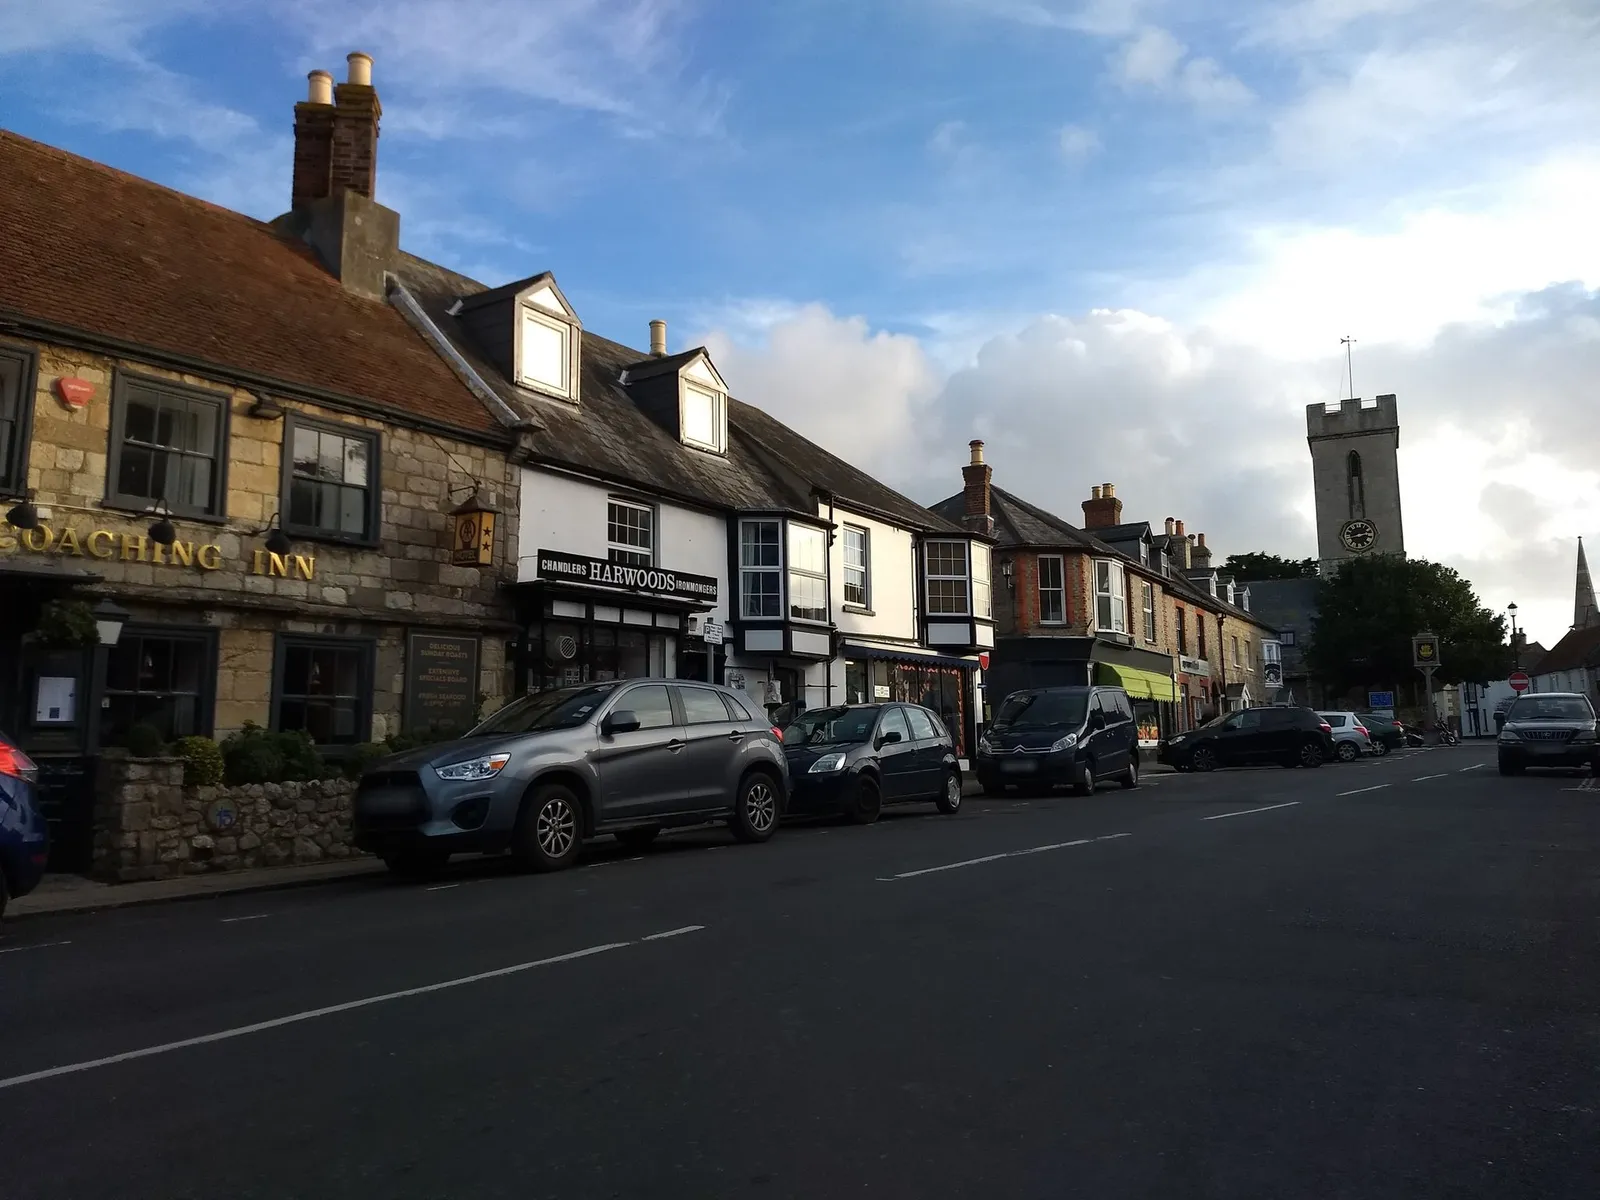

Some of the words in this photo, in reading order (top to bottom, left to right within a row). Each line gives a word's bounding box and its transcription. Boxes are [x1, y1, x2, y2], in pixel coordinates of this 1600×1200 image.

[253, 549, 315, 580] INN
[541, 559, 587, 575] CHANDLERS
[589, 562, 675, 591] HARWOODS
[676, 579, 717, 595] IRONMONGERS
[429, 643, 461, 651] DELICIOUS
[445, 651, 468, 659] ROASTS
